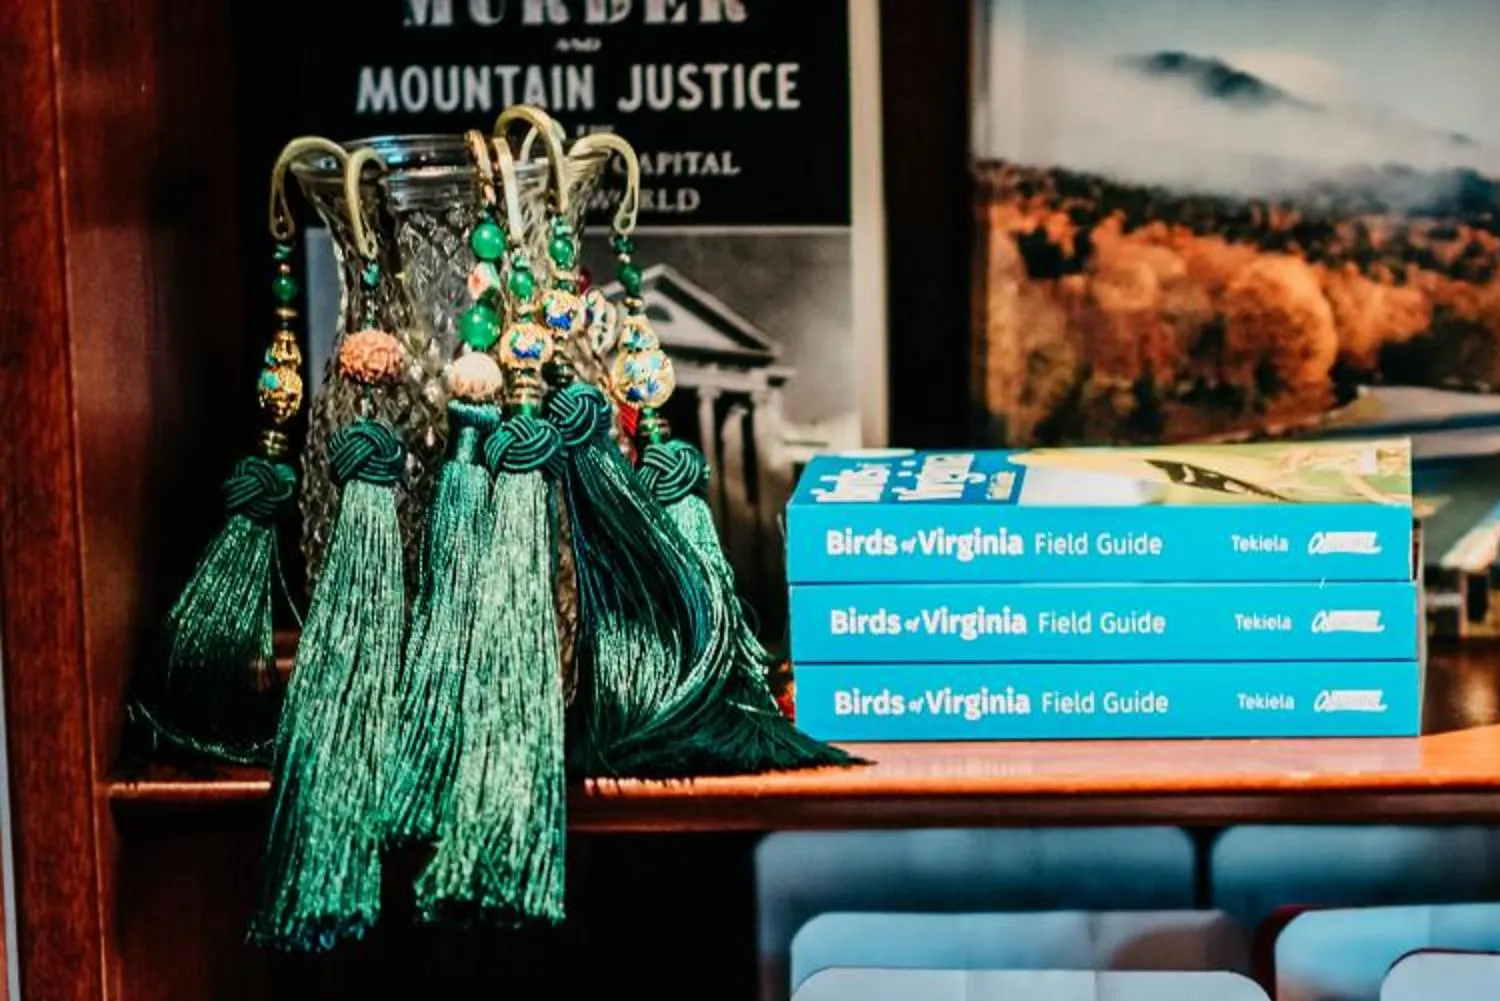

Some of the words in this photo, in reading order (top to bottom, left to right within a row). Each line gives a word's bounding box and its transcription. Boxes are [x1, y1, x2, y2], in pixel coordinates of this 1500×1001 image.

[356, 64, 595, 114] MOUNTAIN
[617, 62, 801, 112] JUSTICE
[826, 529, 898, 555] Birds
[917, 527, 1024, 561] Virginia
[1034, 532, 1088, 555] Field
[1096, 532, 1164, 555] Guide
[1231, 534, 1289, 552] Tekiela
[830, 609, 902, 635] Birds
[920, 606, 1027, 640] Virginia
[1038, 612, 1092, 635] Field
[1099, 611, 1167, 635] Guide
[1234, 613, 1293, 631] Tekiela
[833, 689, 905, 716] Birds
[924, 686, 1031, 721] Virginia
[1042, 691, 1096, 715] Field
[1103, 690, 1170, 715] Guide
[1237, 692, 1295, 710] Tekiela
